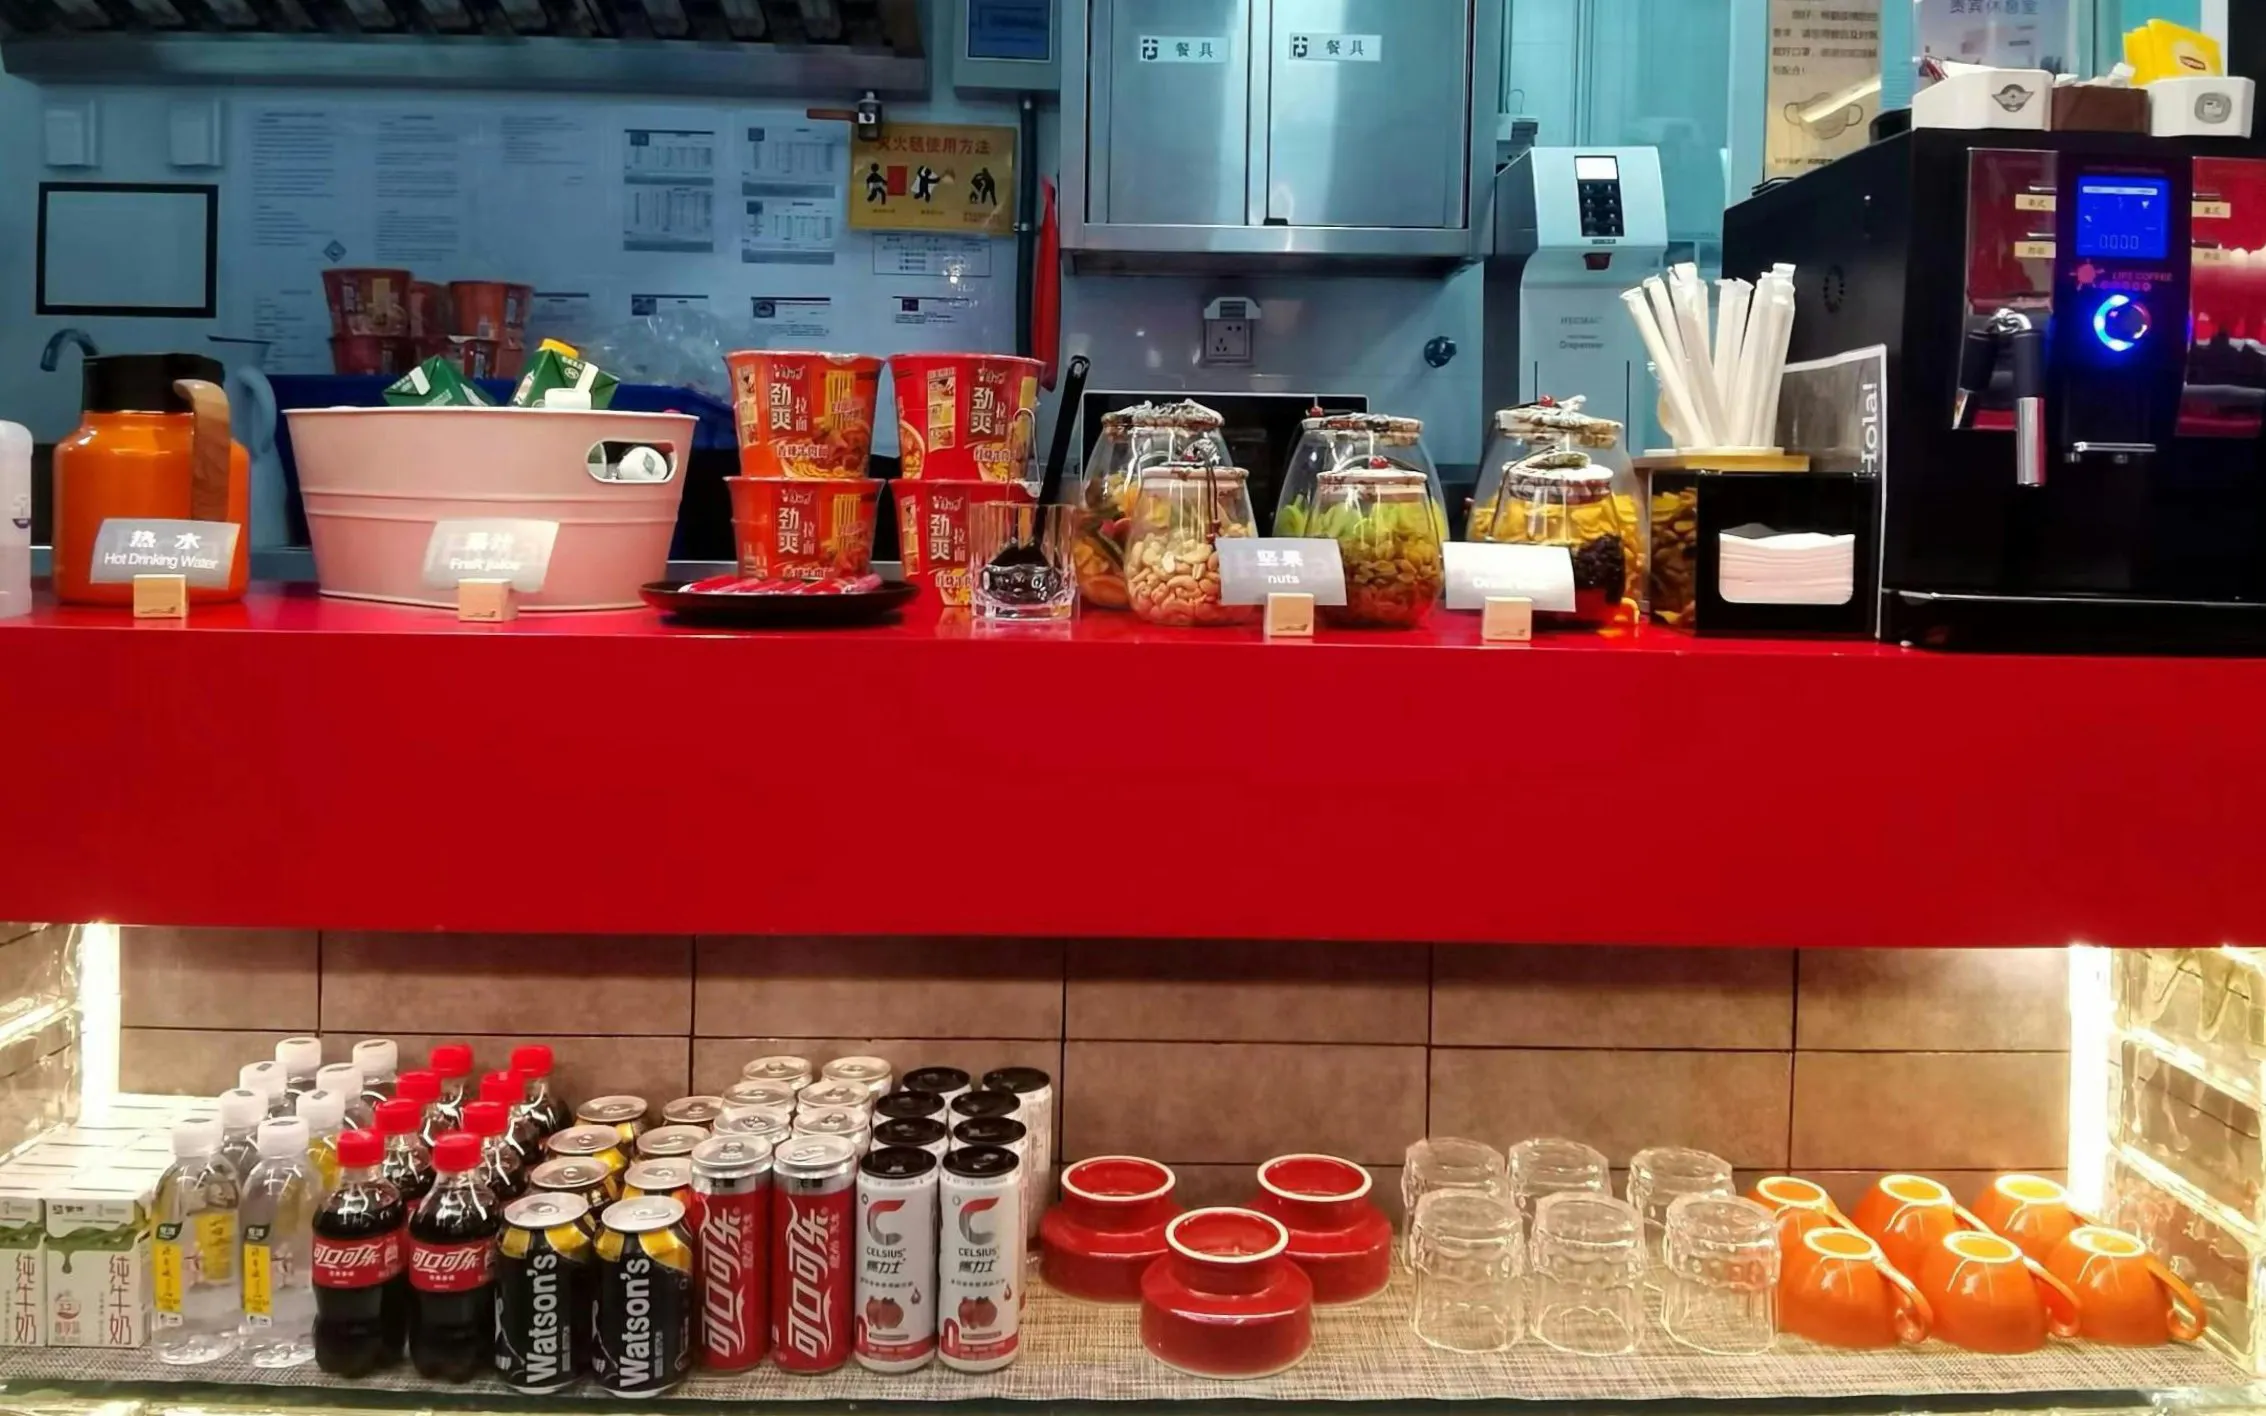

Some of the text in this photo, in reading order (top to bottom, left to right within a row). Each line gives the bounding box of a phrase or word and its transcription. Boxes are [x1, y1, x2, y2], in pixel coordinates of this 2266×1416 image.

[1175, 42, 1214, 58] 餐具
[1326, 39, 1365, 55] 餐具
[770, 382, 792, 431] 劲爽
[970, 387, 994, 434] 劲爽
[778, 507, 800, 554] 劲爽
[930, 514, 950, 560] 劲爽
[104, 552, 219, 570] Hot Drinking Water
[1256, 549, 1304, 568] 坚果
[1267, 574, 1300, 584] nuts
[314, 1243, 384, 1269] 可口可乐
[412, 1247, 484, 1274] 可口可乐
[866, 1245, 904, 1259] CELSIUS
[958, 1247, 997, 1258] CELSIUS
[14, 1252, 37, 1345] 纯牛奶
[108, 1253, 132, 1345] 纯牛奶
[700, 1197, 742, 1358] 可口可乐
[785, 1197, 830, 1359] 可口可乐
[526, 1254, 558, 1384] Watson's
[619, 1258, 651, 1388] Watson's
